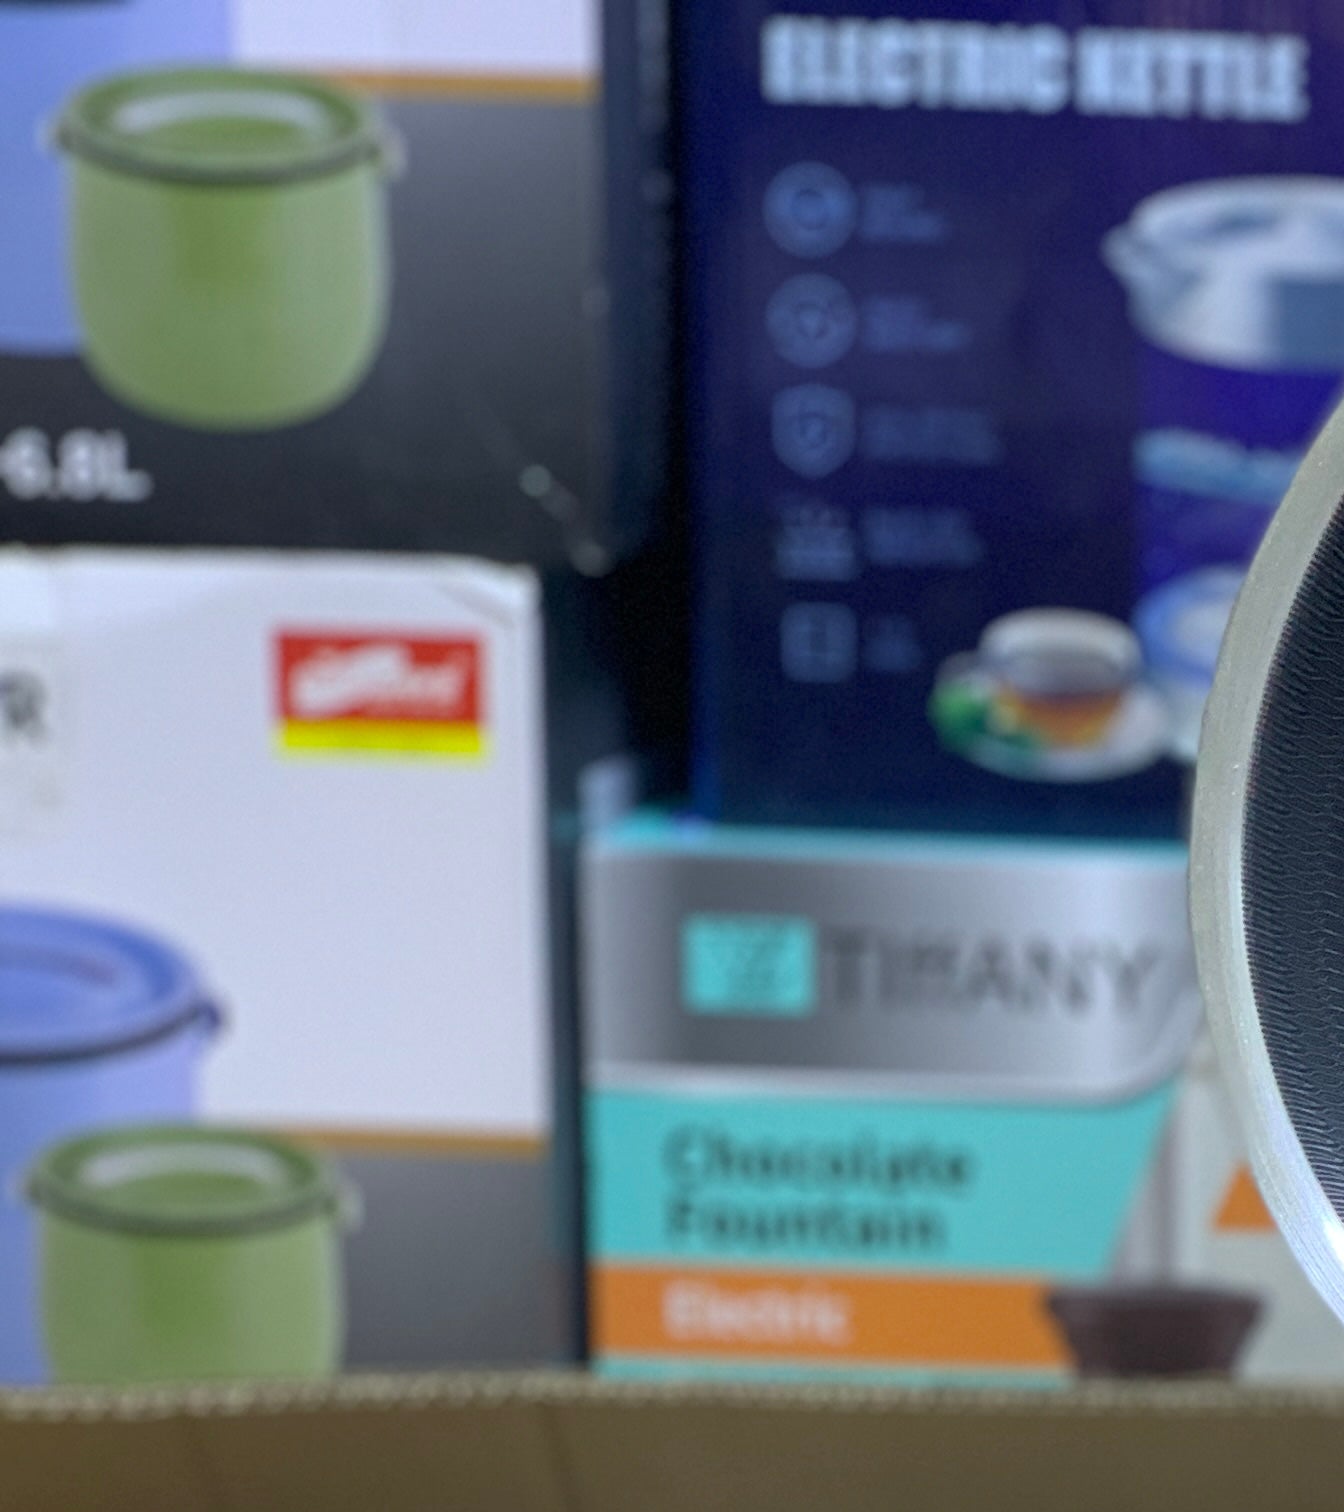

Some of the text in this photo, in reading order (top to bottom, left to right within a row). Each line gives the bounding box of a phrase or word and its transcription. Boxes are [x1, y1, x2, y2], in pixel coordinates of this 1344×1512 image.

[764, 16, 1306, 120] ELECTRIC KETTLE
[663, 1120, 974, 1196] Chocolate
[665, 1198, 948, 1252] Fountain
[662, 1282, 850, 1342] Electric
